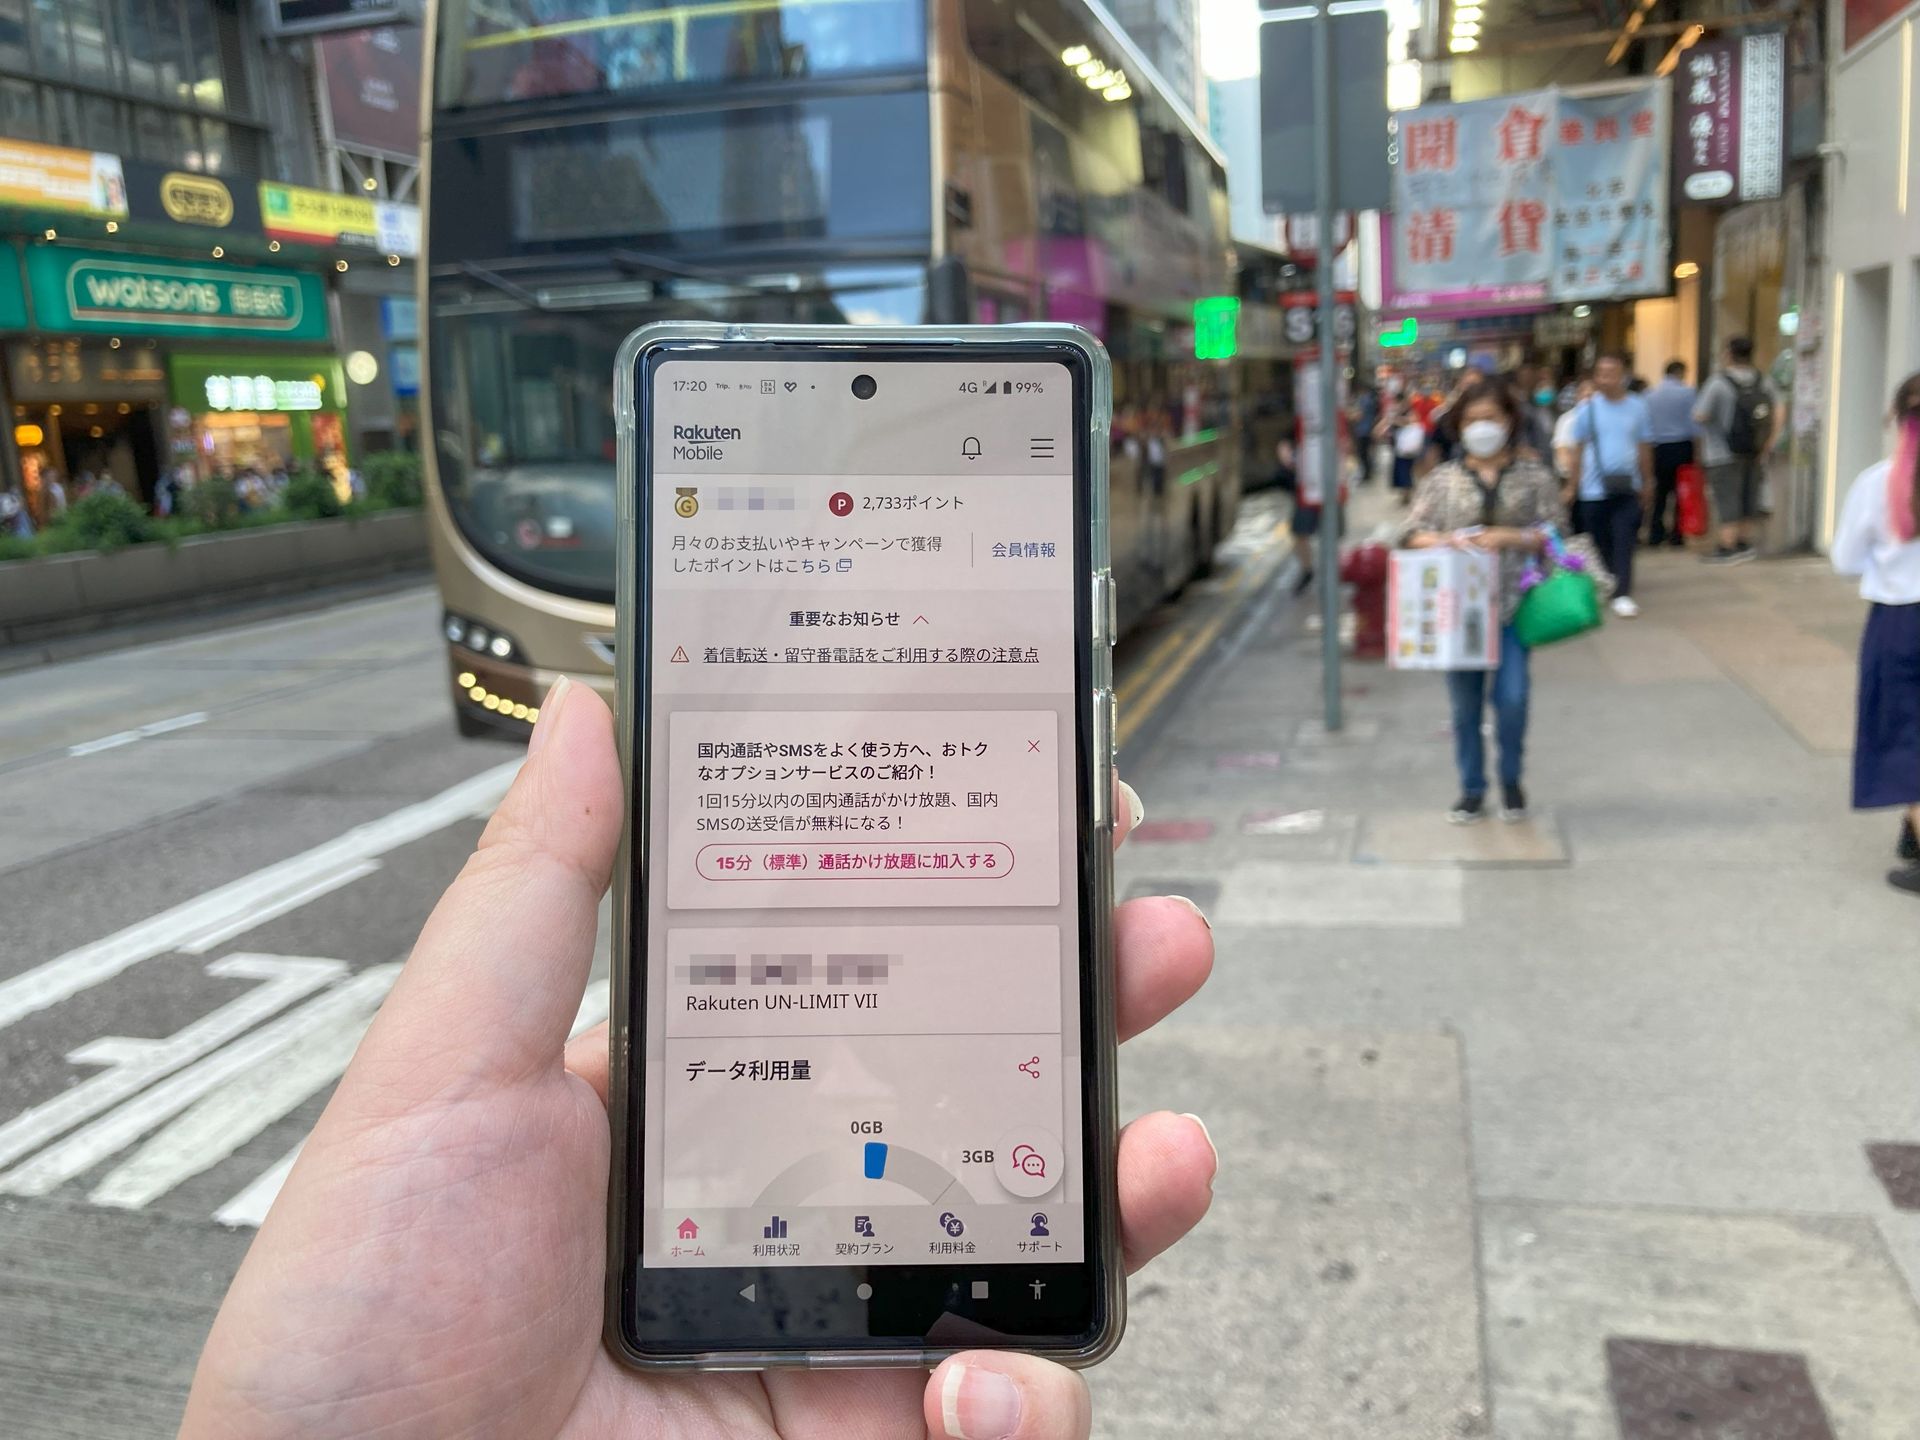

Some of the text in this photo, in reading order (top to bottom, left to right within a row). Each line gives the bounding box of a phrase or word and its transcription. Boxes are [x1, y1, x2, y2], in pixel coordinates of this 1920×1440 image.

[86, 275, 221, 313] watsons
[673, 380, 707, 392] 17:20
[959, 382, 978, 394] 4G
[1016, 382, 1044, 394] 99%
[673, 425, 741, 441] Rakuten
[673, 445, 723, 461] Mobile
[863, 495, 964, 512] 2,733ポイント
[671, 535, 943, 553] 月々のお支払いやキャンペーンで獲得
[991, 541, 1056, 559] 会員情報
[673, 557, 831, 574] したポイントはこちら
[789, 610, 900, 628] 重要なお知らせ
[703, 646, 1040, 664] 着信転送・留守番電話をご利用する際の注意点
[697, 741, 989, 760] 国内通話やSMSをよく使う方へ、おトク
[697, 764, 936, 782] なオプションサービスのご紹介！
[697, 791, 999, 809] 1回15分以内の国内通話がかけ放題、国内
[696, 815, 904, 833] SMSの送受信が無料になる！
[716, 852, 997, 872] 15分（標準）通話かけ放題に加入する
[686, 992, 878, 1011] Rakuten UN-LIMIT VII
[686, 1059, 812, 1082] データ利用量
[850, 1120, 883, 1134] 0GB
[962, 1150, 994, 1164] 3GB
[671, 1240, 1063, 1258] ホーム 利用状況 契約プラン 利用料金 サポート
